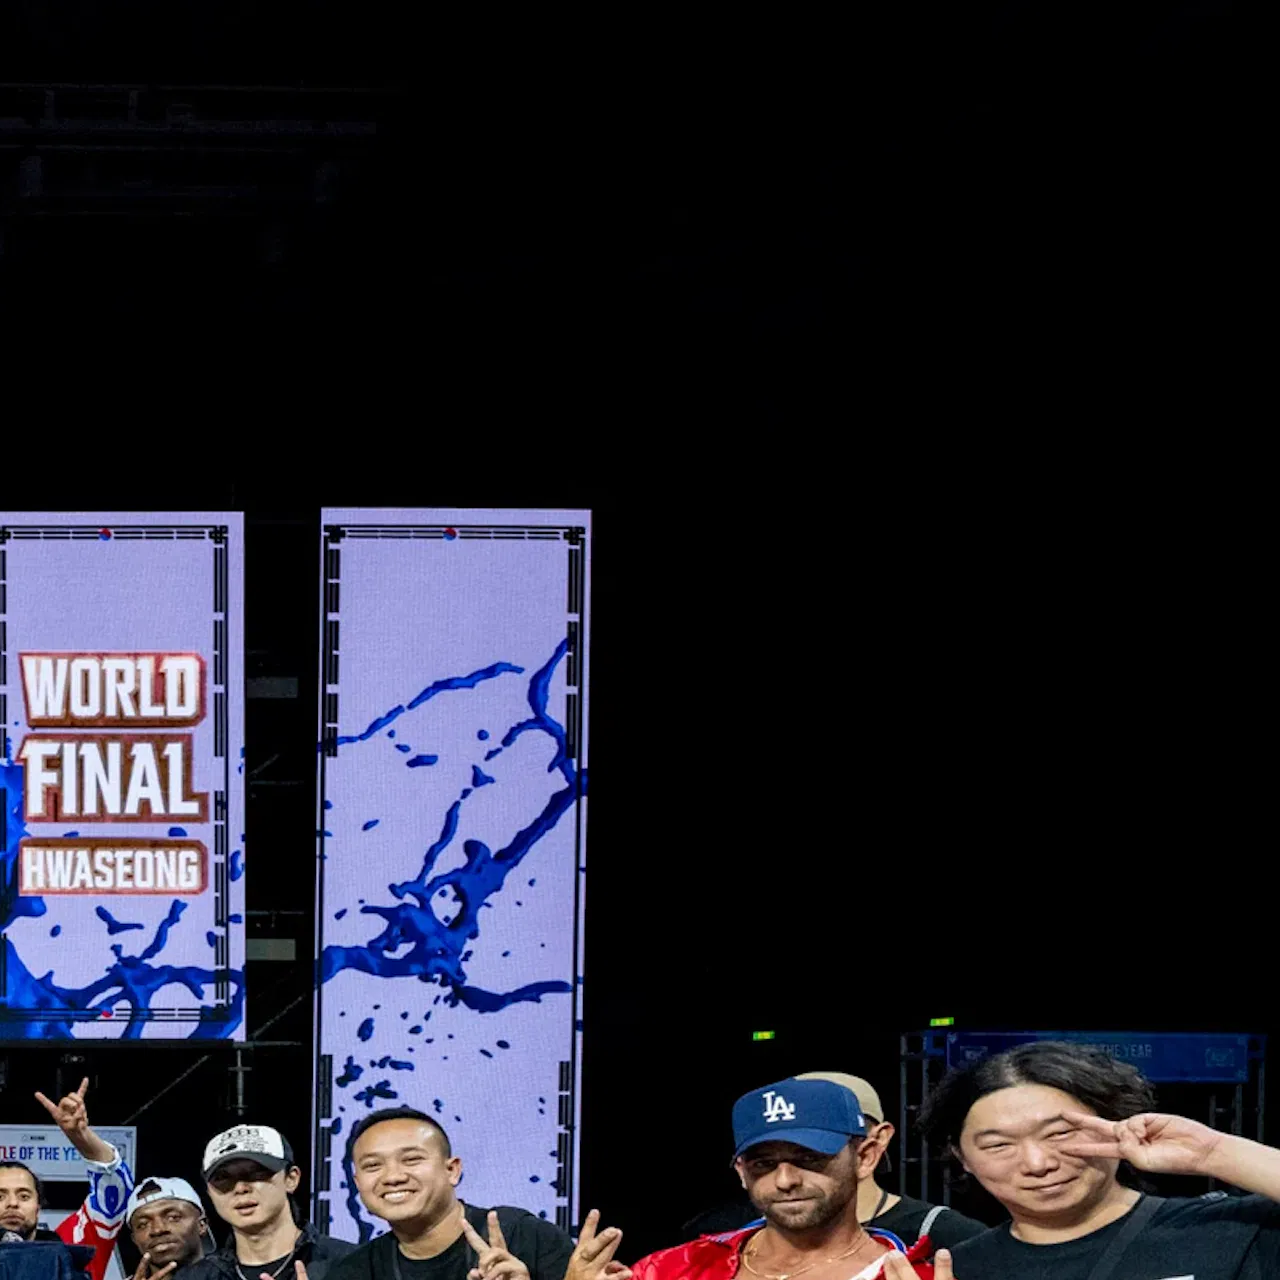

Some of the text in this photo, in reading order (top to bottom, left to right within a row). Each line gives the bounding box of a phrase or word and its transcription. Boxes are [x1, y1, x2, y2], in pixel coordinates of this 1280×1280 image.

[22, 656, 200, 719] WORLD
[22, 739, 202, 816] FINAL
[21, 845, 202, 890] HWASEONG
[762, 1091, 796, 1122] LA
[20, 1146, 34, 1159] OF
[40, 1147, 59, 1160] THE
